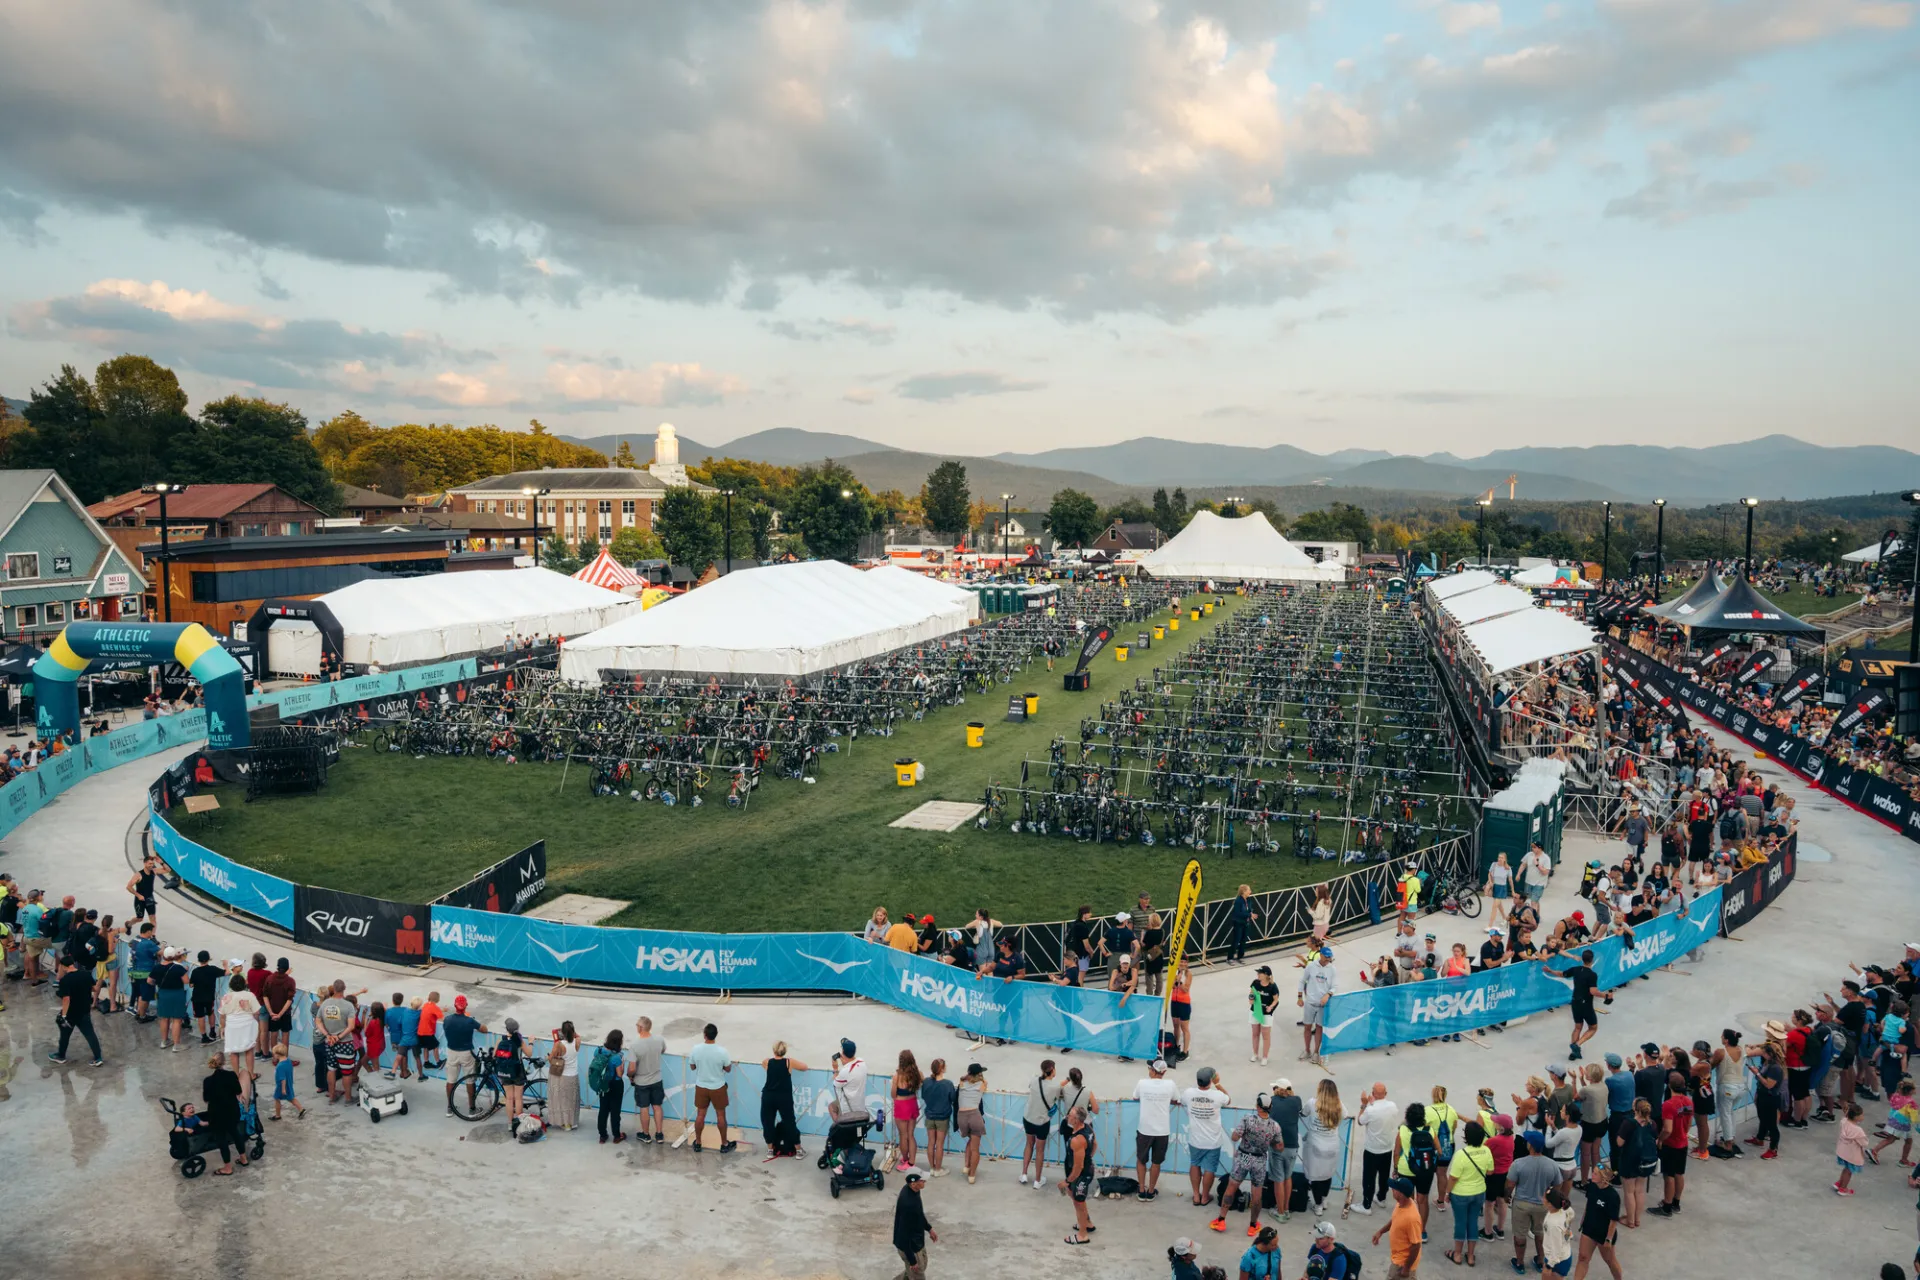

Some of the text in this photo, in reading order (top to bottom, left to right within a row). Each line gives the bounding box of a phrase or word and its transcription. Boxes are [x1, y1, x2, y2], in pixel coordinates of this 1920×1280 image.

[1333, 549, 1340, 558] 3
[1723, 610, 1781, 620] IRONMAN
[94, 629, 151, 642] ATHLETIC
[1700, 644, 1731, 667] IRONMAN
[118, 660, 141, 668] Hyperice
[1738, 656, 1773, 684] IRONMAN
[421, 669, 445, 680] ATHLETIC
[355, 681, 380, 692] ATHLETIC
[1782, 672, 1820, 703] IRONMAN
[284, 694, 311, 706] ATHLETIC
[1643, 682, 1680, 717] IRONMAN
[377, 698, 409, 715] QATAR
[1838, 694, 1883, 729] IRONMAN
[387, 710, 411, 720] AIRWAYS
[109, 733, 139, 750] ATHLETIC
[55, 757, 74, 776] ATHLETIC
[9, 785, 27, 807] ATHLETIC
[1872, 793, 1902, 815] wahoo
[515, 878, 546, 904] MAURTEN
[1724, 889, 1746, 917] HOKA
[464, 923, 478, 932] FLY
[1169, 892, 1194, 967] CROSSWALK
[464, 933, 496, 944] HUMAN
[464, 939, 478, 949] FLY
[636, 945, 718, 974] HOKA
[719, 949, 736, 958] FLY
[1619, 933, 1661, 973] HOKA
[719, 957, 757, 967] HUMAN
[719, 965, 736, 974] FLY
[900, 969, 969, 1014] HOKA
[969, 989, 984, 1000] FLY
[1486, 983, 1500, 994] FLY
[1487, 988, 1516, 1001] HUMAN
[969, 1000, 1006, 1013] HUMAN
[969, 1007, 984, 1017] FLY
[1410, 987, 1487, 1024] HOKA
[1486, 1000, 1499, 1011] FLY
[1596, 1199, 1606, 1208] DC
